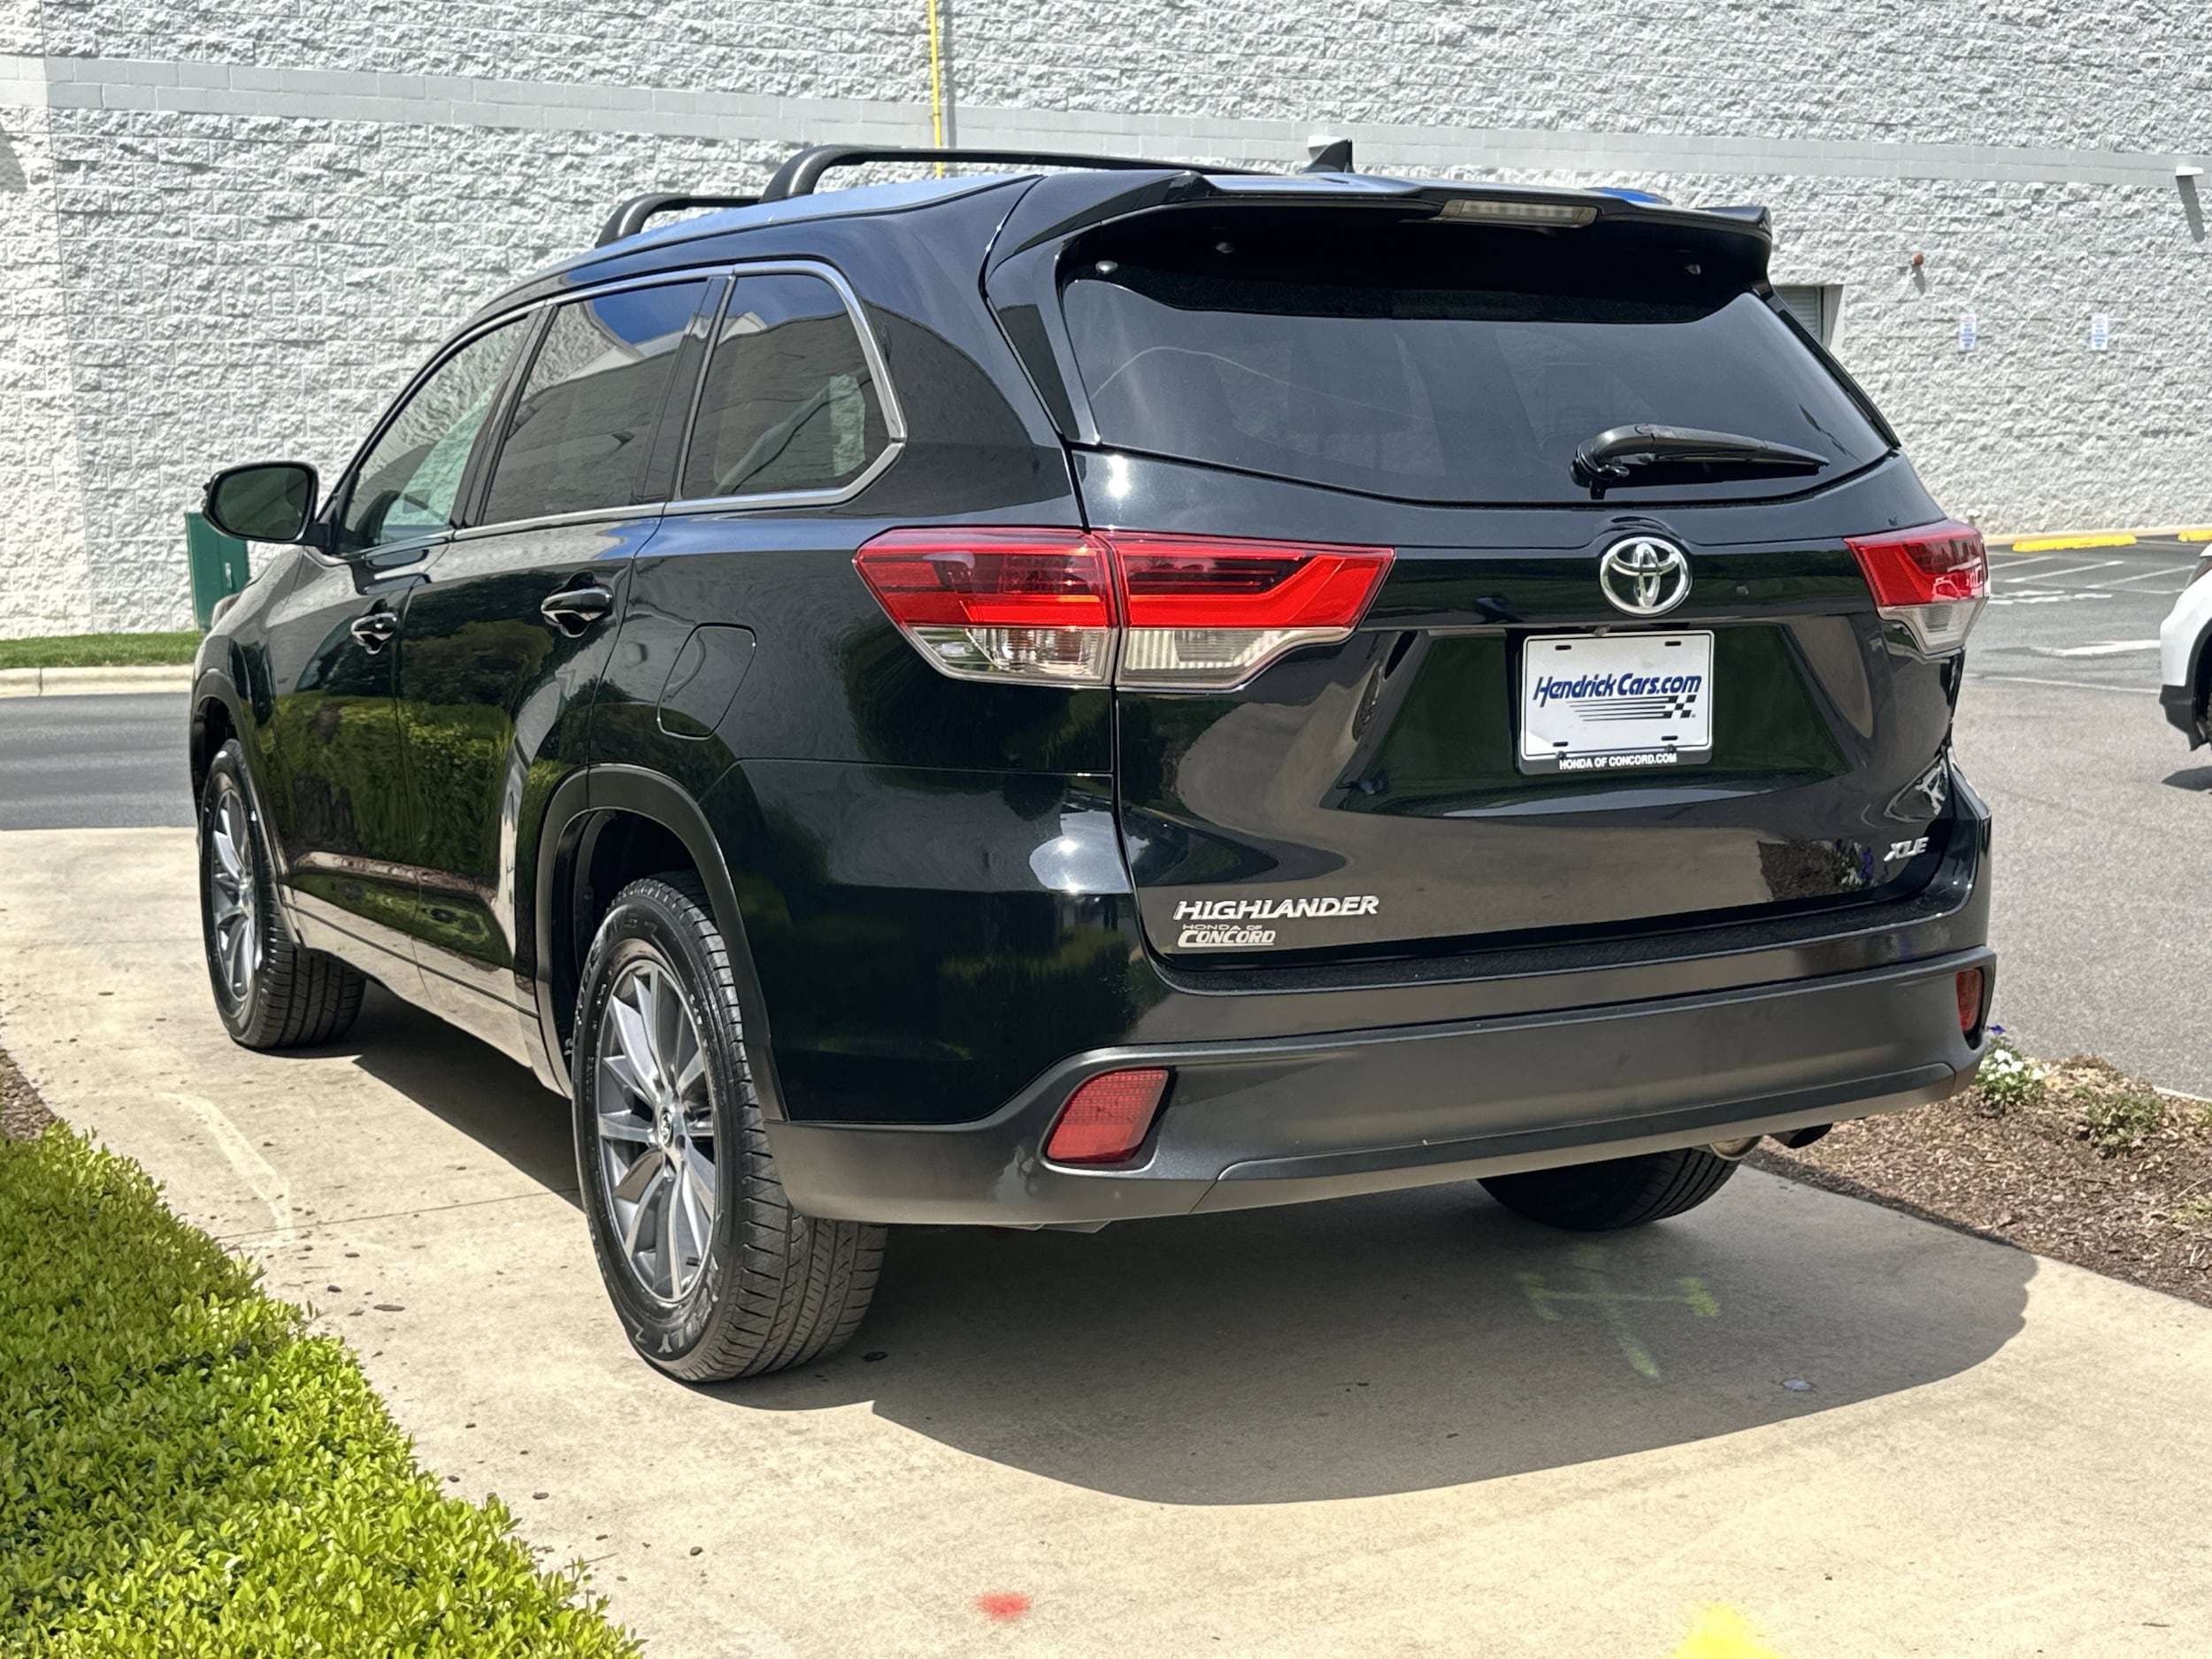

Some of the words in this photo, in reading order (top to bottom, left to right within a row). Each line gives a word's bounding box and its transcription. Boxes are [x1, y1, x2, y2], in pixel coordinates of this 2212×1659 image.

[1559, 757, 1593, 770] HONDA
[1594, 757, 1608, 768] OF
[1609, 753, 1677, 767] CONCORD.COM
[1884, 836, 1929, 862] XLE
[1172, 895, 1379, 920] HIGHLANDER
[1178, 930, 1276, 948] CONCORD
